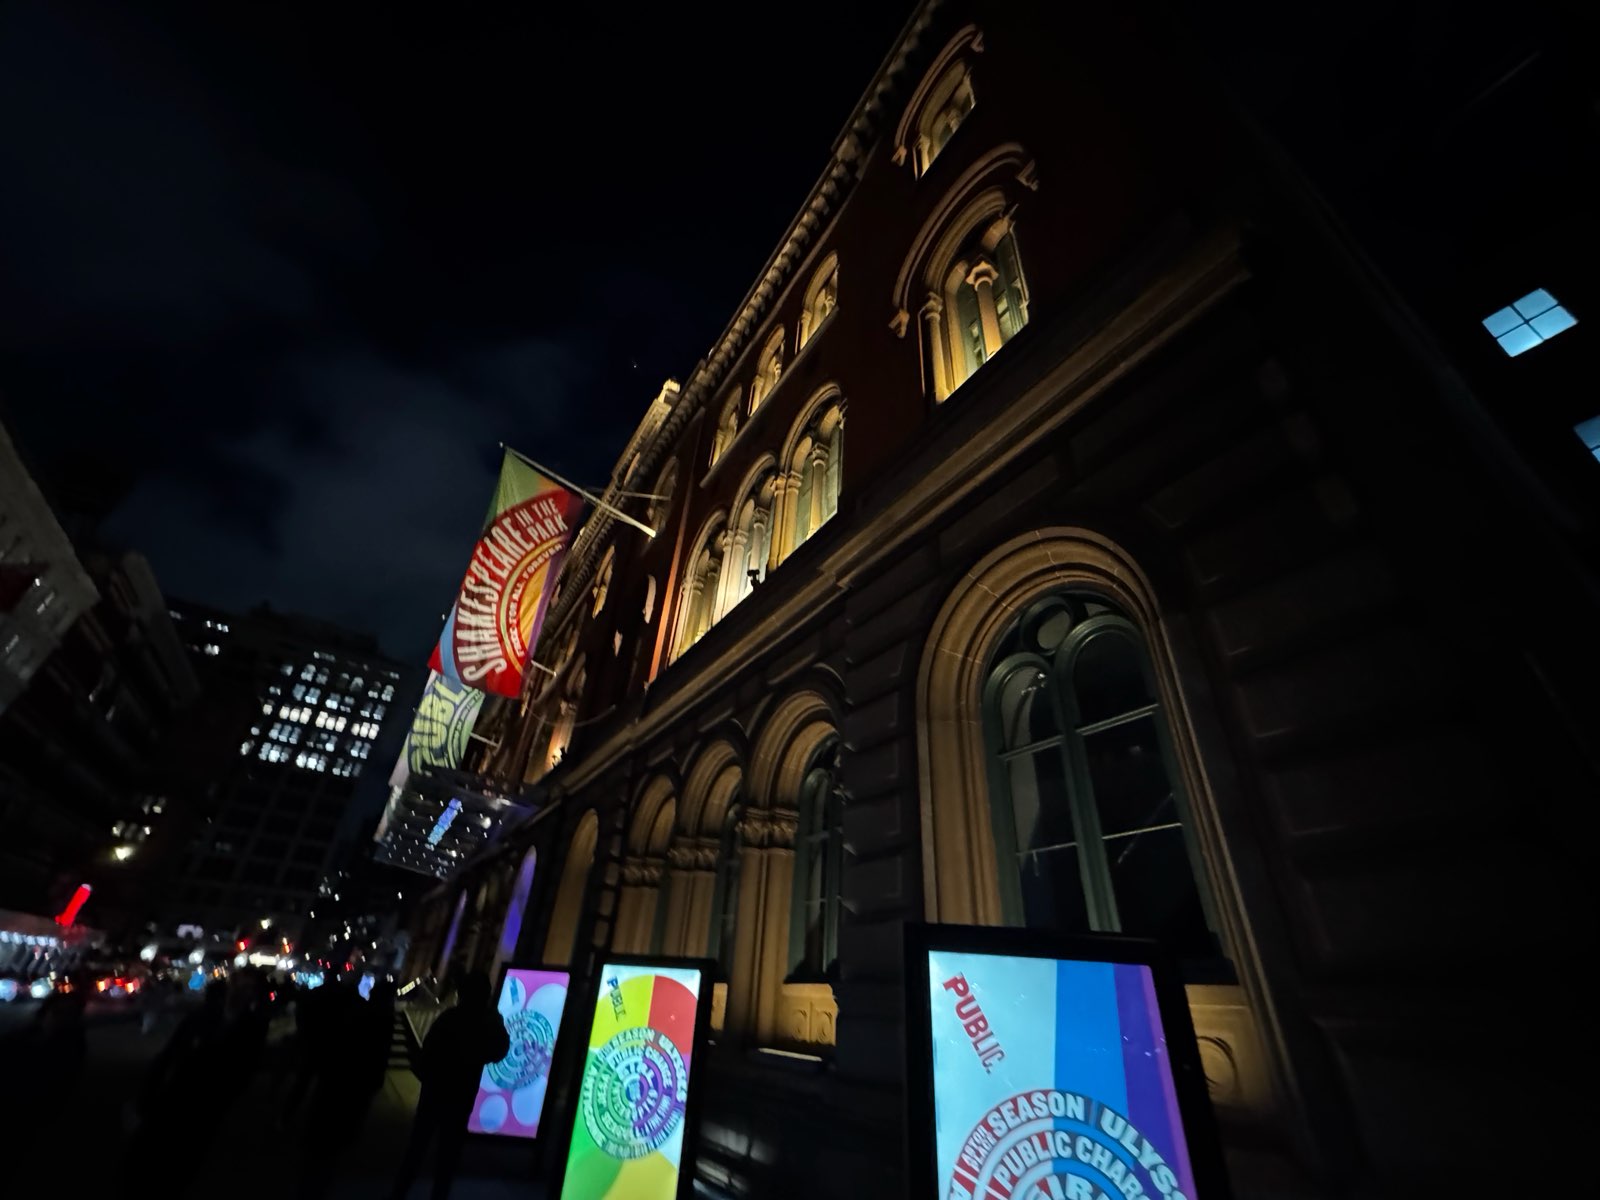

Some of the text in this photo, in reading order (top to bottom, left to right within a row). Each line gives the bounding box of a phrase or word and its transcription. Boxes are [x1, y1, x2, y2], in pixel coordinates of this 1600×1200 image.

[514, 498, 560, 527] IN THE
[527, 513, 568, 543] PARK
[456, 517, 536, 681] SHAKESPEARE
[986, 1091, 1086, 1138] SEASON
[993, 1131, 1150, 1200] PUBLIC CHAR
[1100, 1108, 1188, 1200] ULYS
